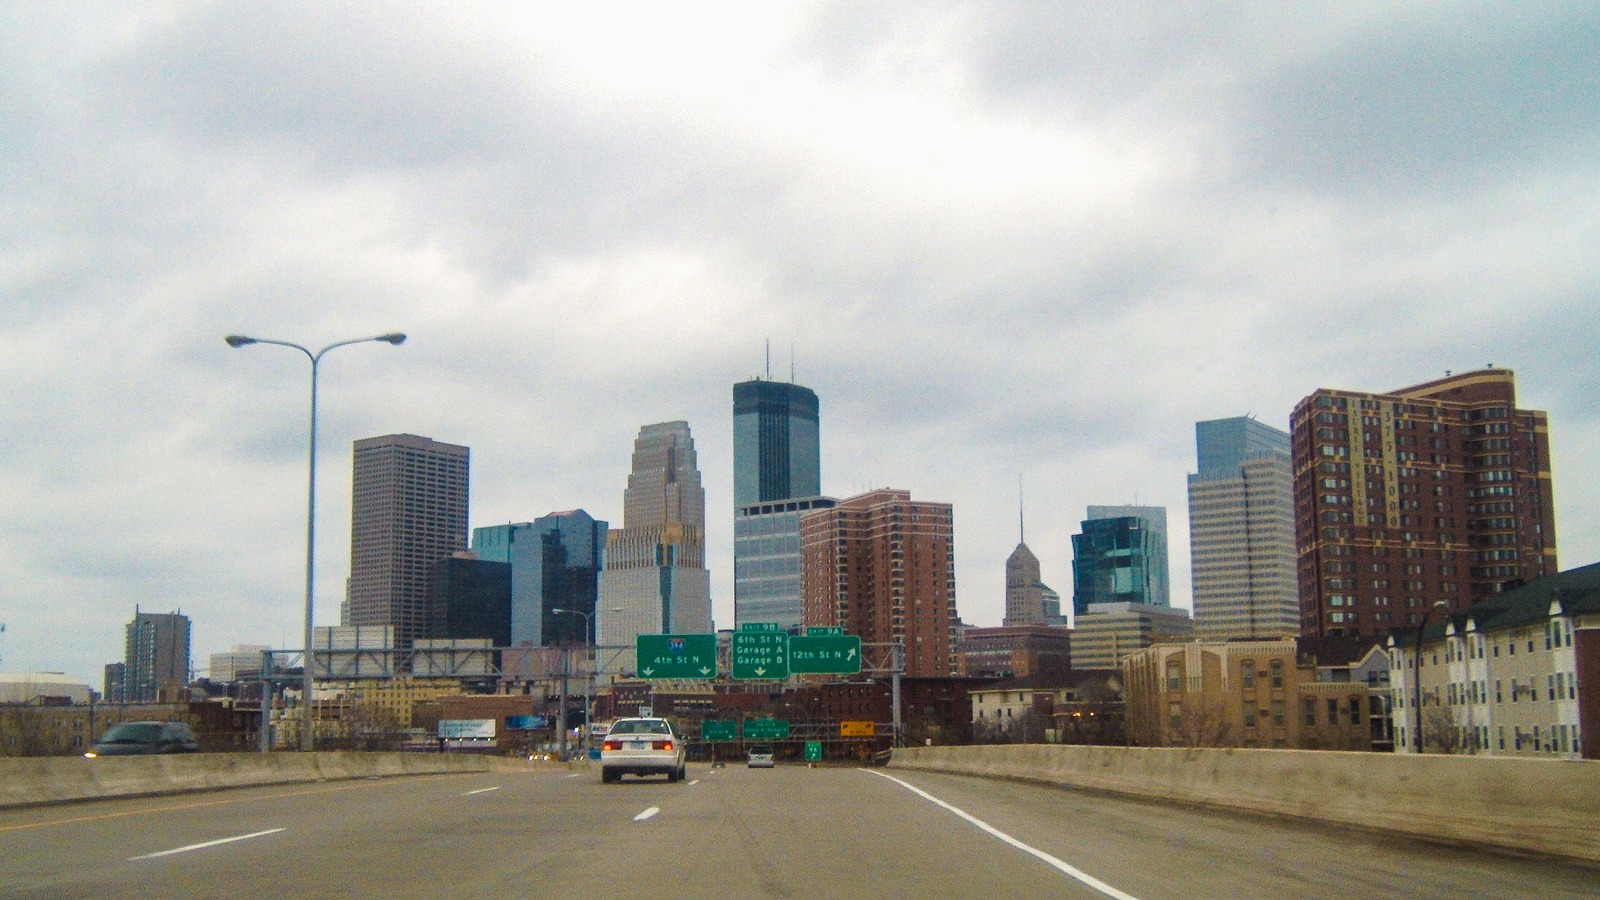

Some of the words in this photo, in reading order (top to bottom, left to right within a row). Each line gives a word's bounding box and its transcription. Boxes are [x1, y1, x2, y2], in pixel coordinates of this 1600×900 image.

[738, 636, 755, 644] 6th
[760, 636, 770, 644] St
[737, 646, 771, 656] Garage
[793, 651, 814, 659] 12th
[819, 651, 829, 659] St
[654, 656, 672, 664] 4th
[677, 656, 687, 664] St
[737, 656, 771, 666] Garage
[776, 656, 783, 664] B
